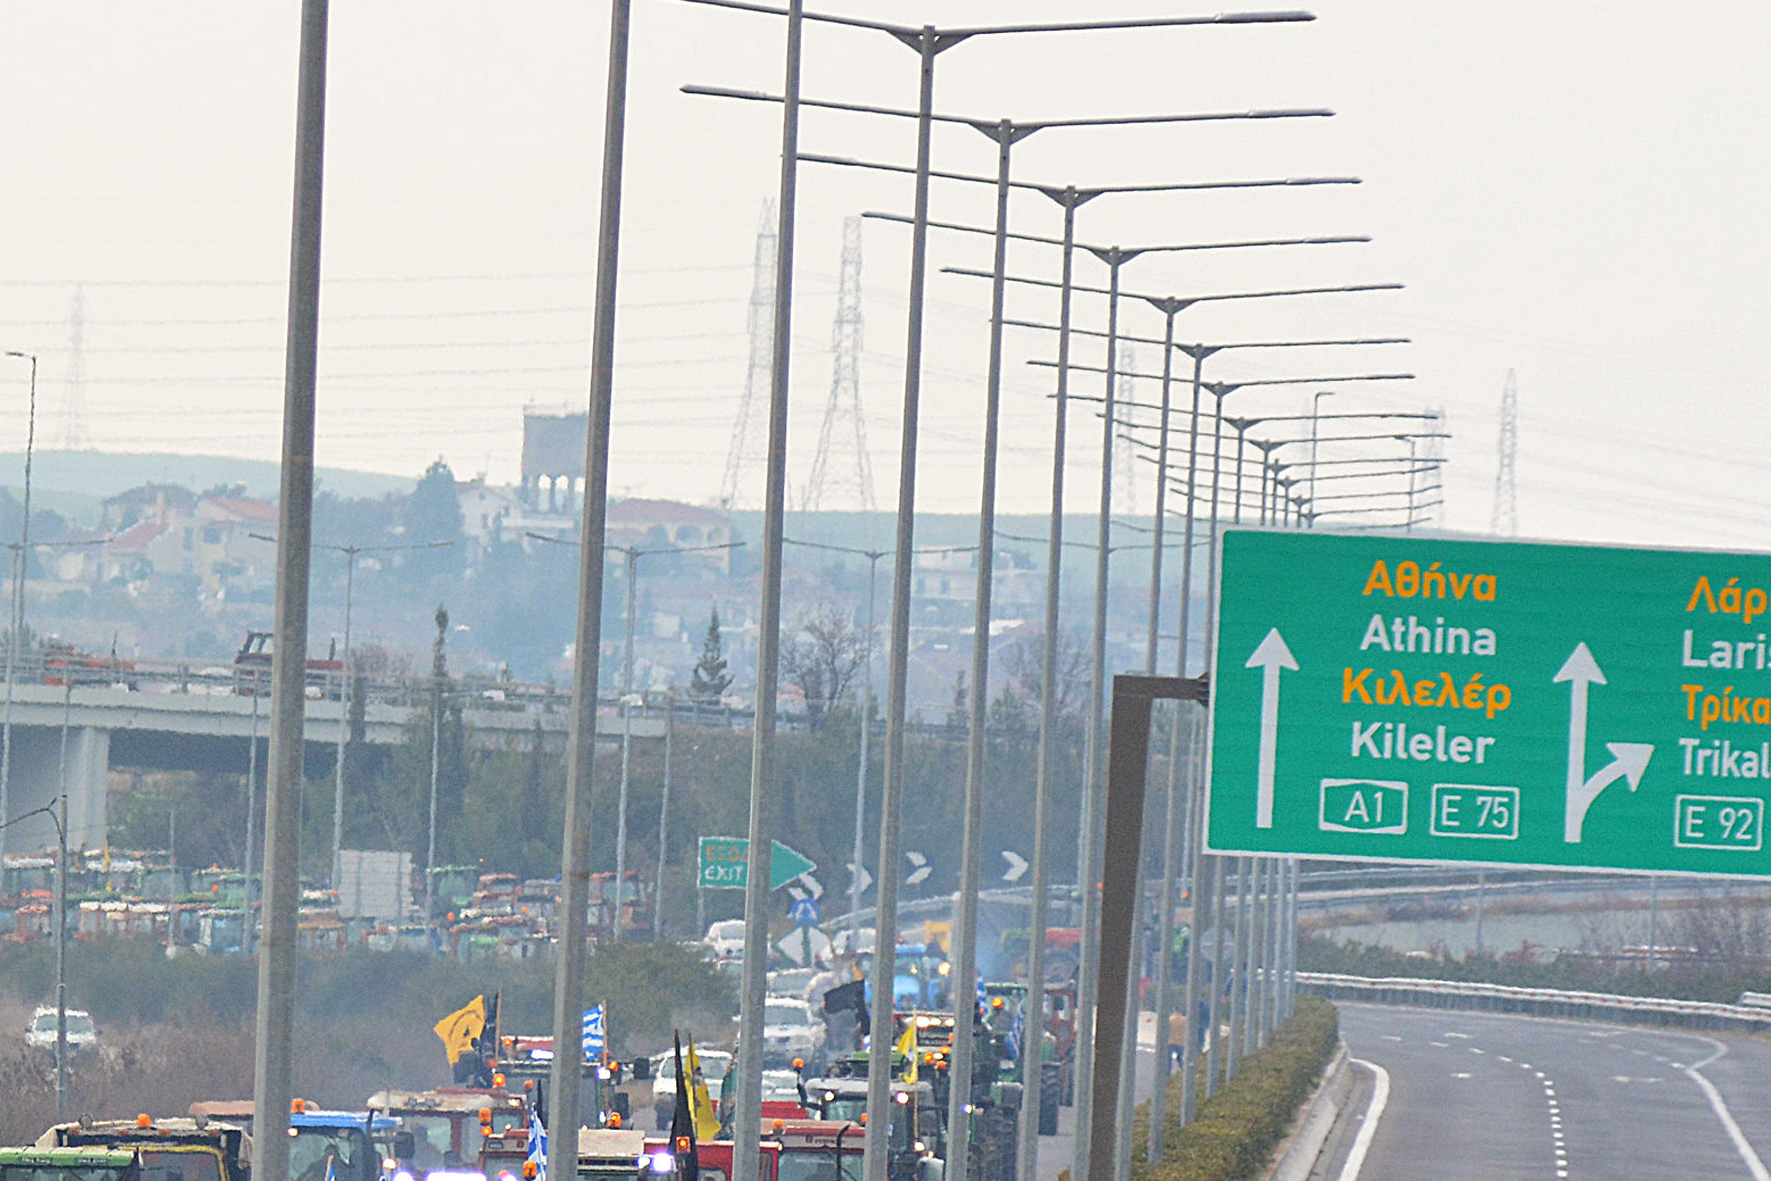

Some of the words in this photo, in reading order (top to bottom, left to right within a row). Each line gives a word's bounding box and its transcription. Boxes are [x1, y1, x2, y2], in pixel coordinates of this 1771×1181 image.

[1361, 559, 1498, 601] Αθήνα
[1685, 575, 1771, 625] Λάρ
[1359, 613, 1497, 656] Athina
[1681, 629, 1771, 671] Lari
[1341, 667, 1512, 719] Κιλελέρ
[1350, 721, 1497, 764] Kileler
[1343, 790, 1384, 823] A1
[1441, 794, 1463, 827] E
[1475, 796, 1510, 829] 75
[1685, 805, 1707, 838] E
[1718, 807, 1754, 840] 92
[704, 865, 744, 880] EXIT
